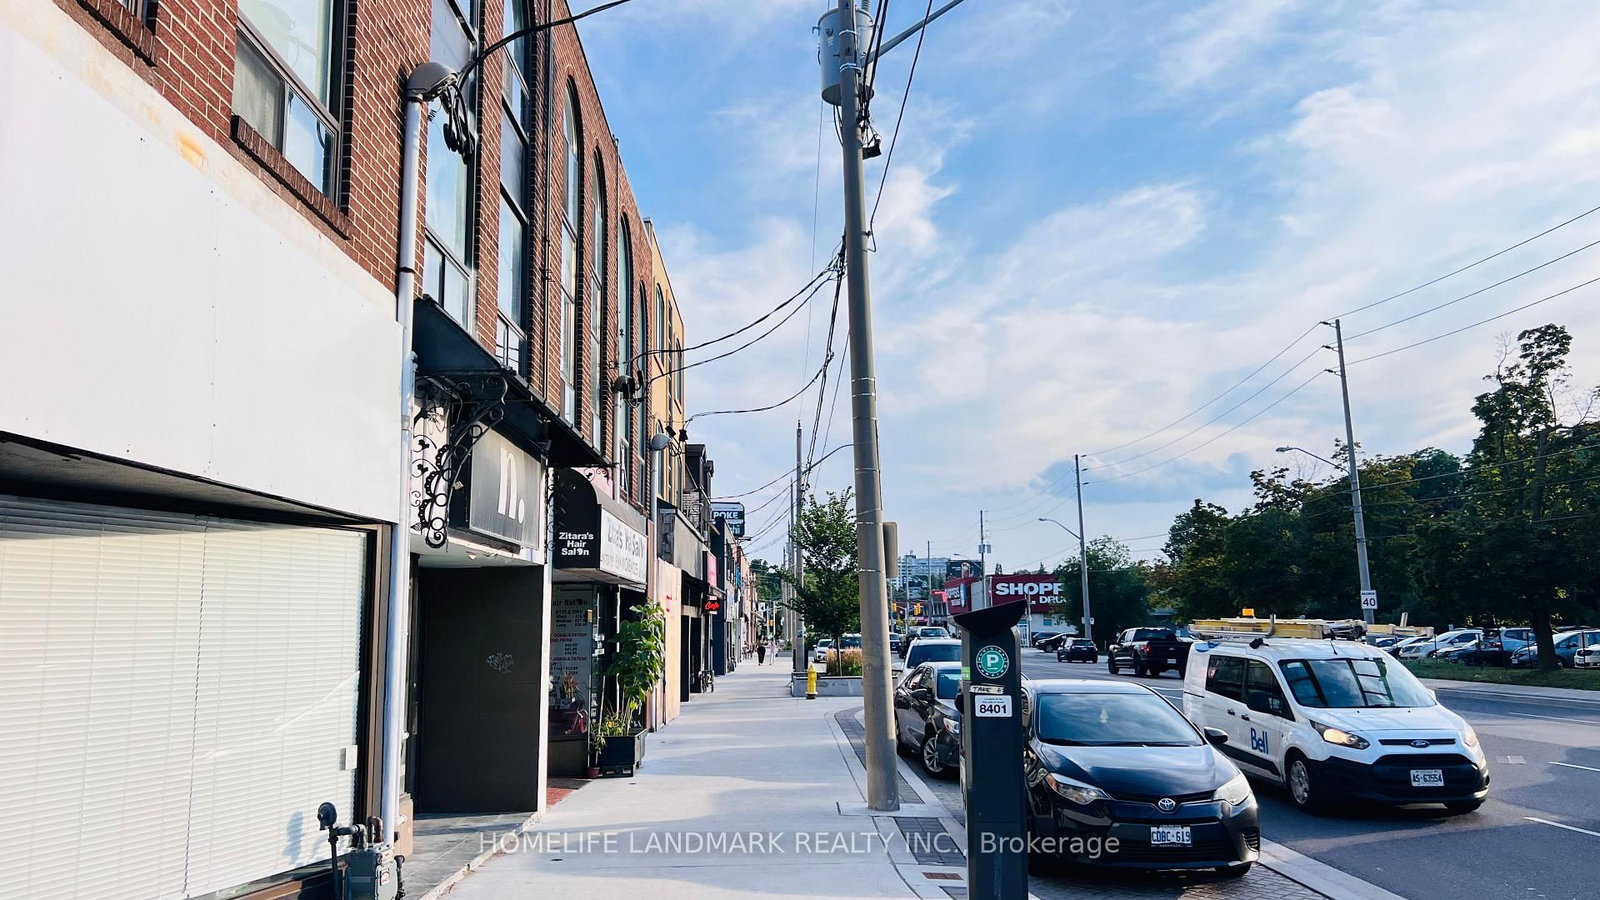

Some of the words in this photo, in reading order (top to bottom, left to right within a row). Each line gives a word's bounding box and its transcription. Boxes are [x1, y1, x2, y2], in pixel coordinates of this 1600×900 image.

[558, 532, 594, 540] Zitara's
[566, 540, 587, 548] Hair
[1363, 598, 1376, 607] 40
[979, 704, 1007, 714] 8401
[1250, 726, 1269, 755] Bell
